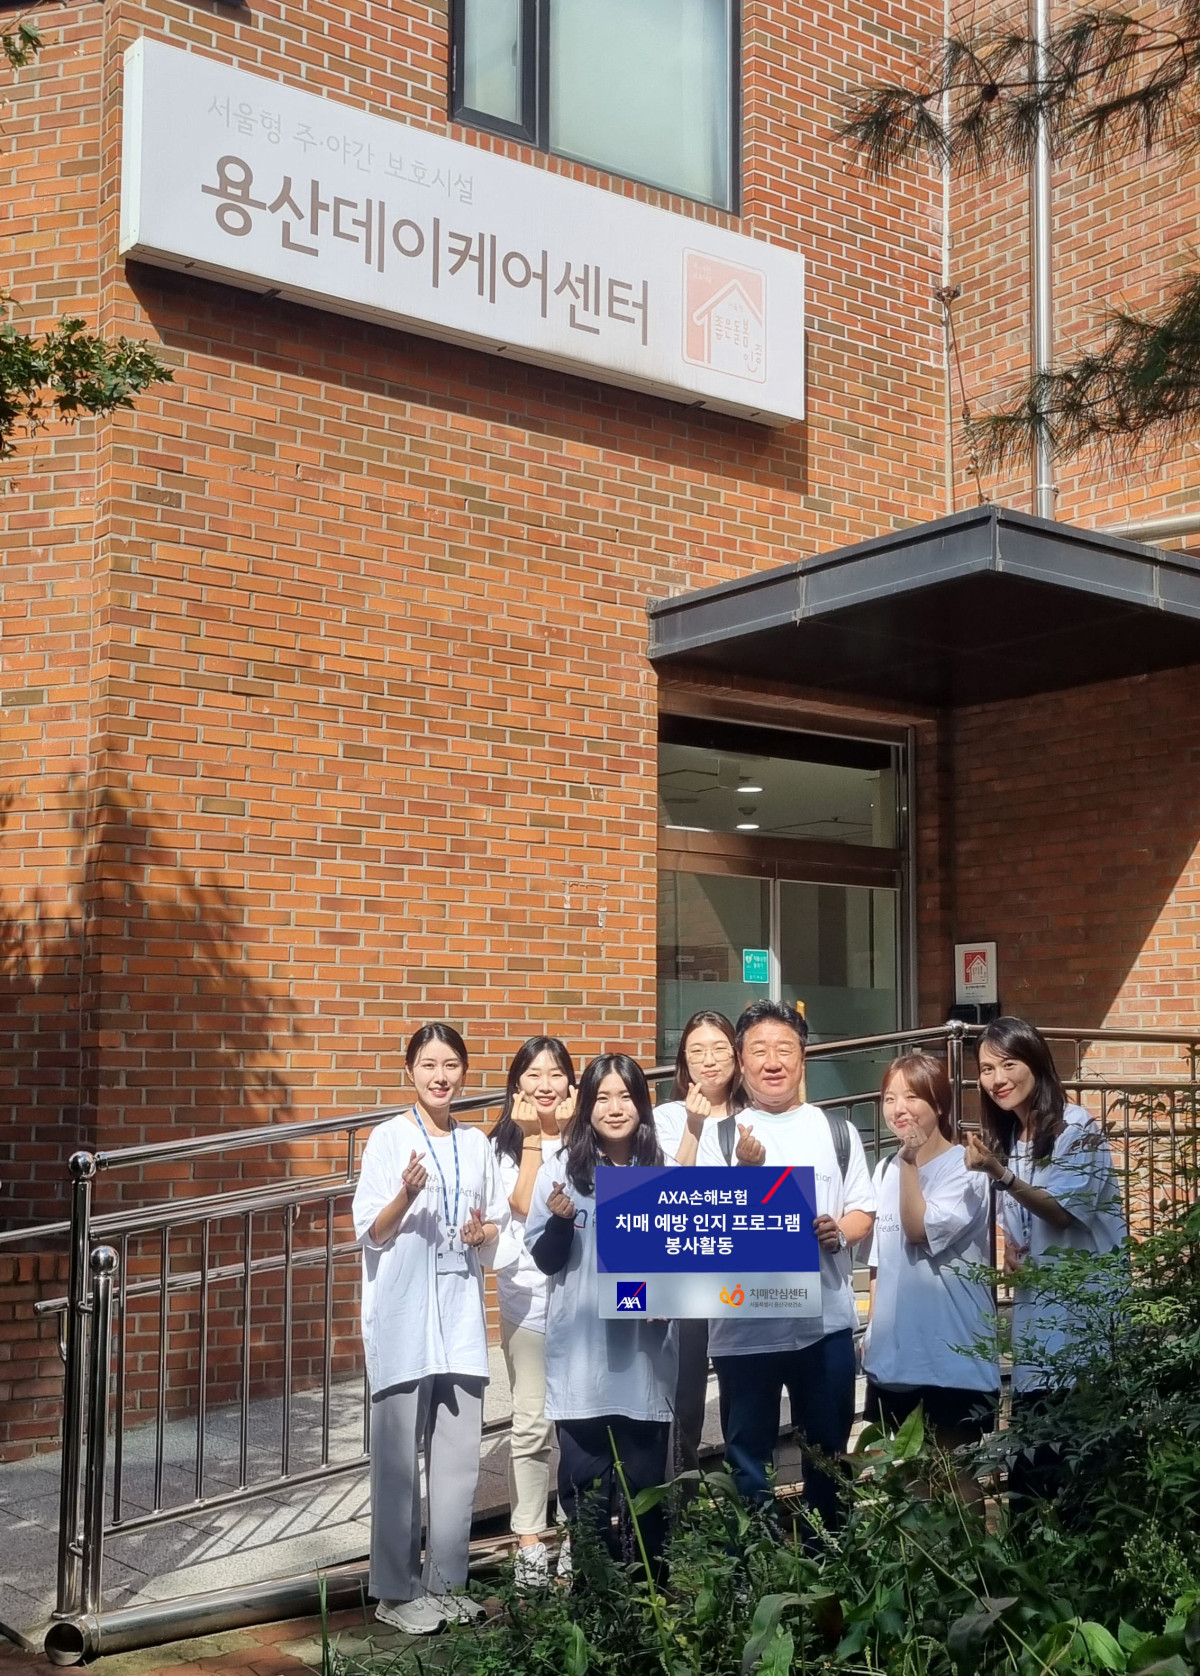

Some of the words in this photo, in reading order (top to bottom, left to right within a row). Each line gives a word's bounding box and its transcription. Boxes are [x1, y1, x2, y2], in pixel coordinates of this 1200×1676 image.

[207, 96, 282, 144] 서울형
[384, 153, 474, 205] 보호시설
[201, 155, 649, 346] 용산데이케어센터
[657, 1189, 748, 1206] AXA손해보험
[615, 1213, 650, 1233] 치매
[654, 1213, 689, 1233] 예방
[693, 1213, 727, 1233] 인지
[731, 1213, 801, 1233] 프로그램
[664, 1236, 734, 1256] 봉사활동
[616, 1296, 642, 1309] AXA
[749, 1288, 808, 1300] 치매안심센터
